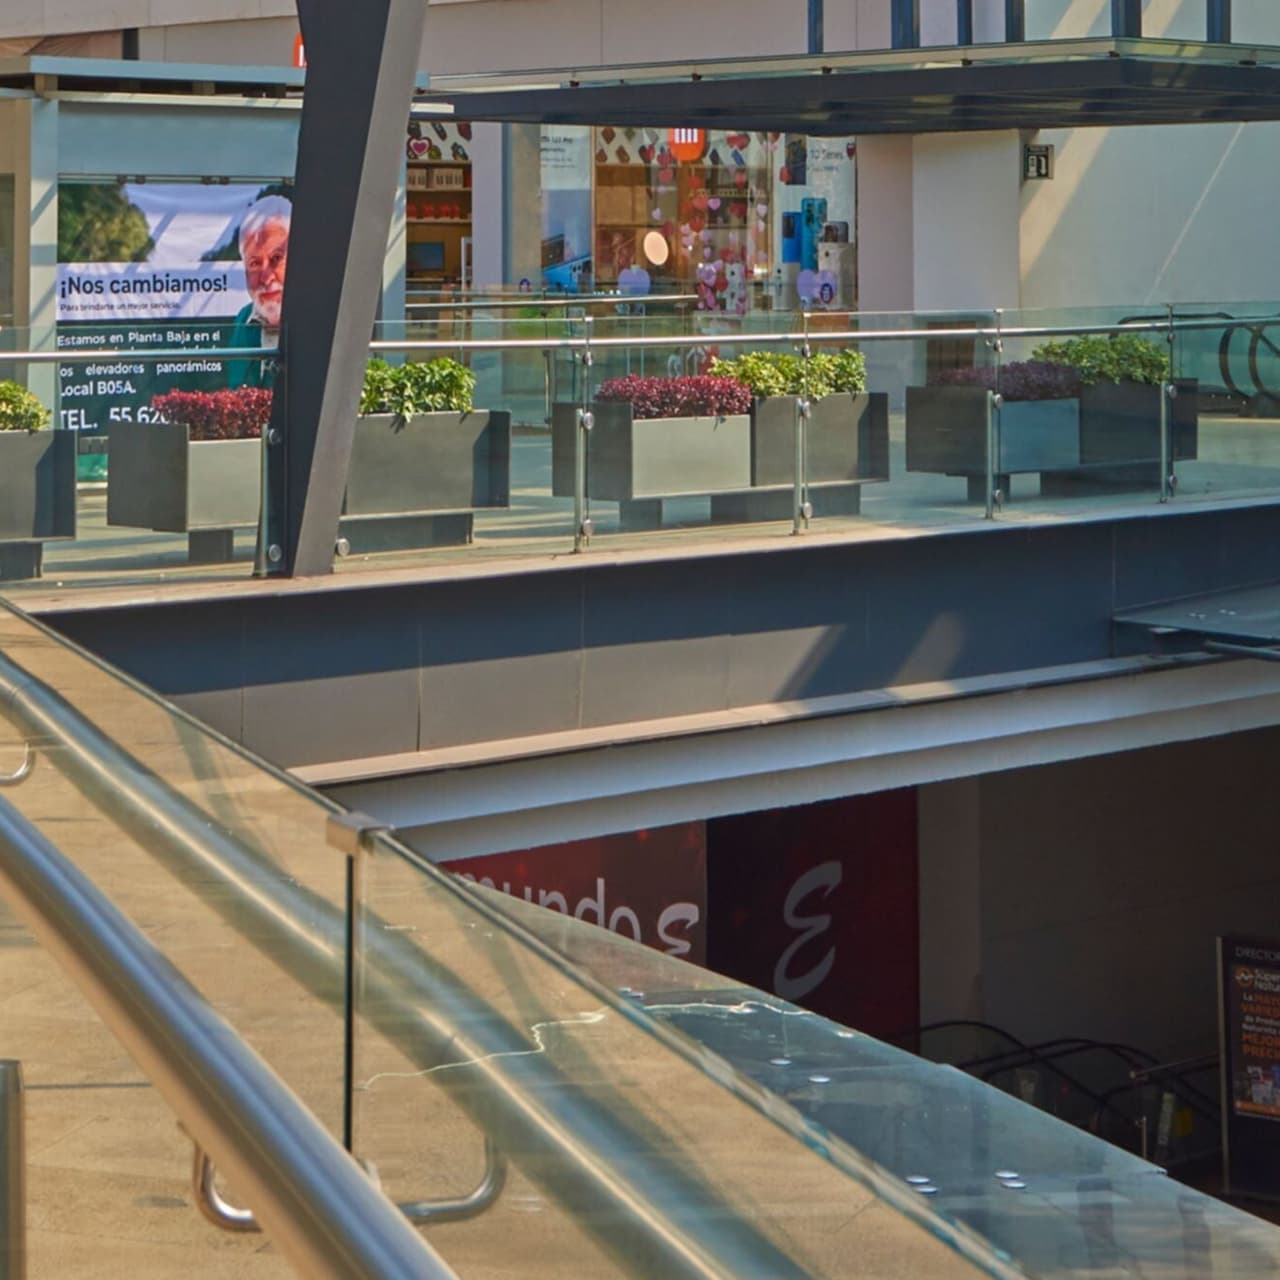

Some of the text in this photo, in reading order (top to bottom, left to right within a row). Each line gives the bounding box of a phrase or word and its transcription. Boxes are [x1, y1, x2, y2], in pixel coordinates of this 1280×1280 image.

[60, 274, 228, 299] ¡Nos cambiamos!
[57, 334, 106, 347] Estamos
[110, 333, 124, 343] en
[128, 331, 163, 344] Planta
[166, 329, 191, 345] Baja
[193, 330, 210, 341] en
[60, 359, 222, 377] os elevadores panorámicos
